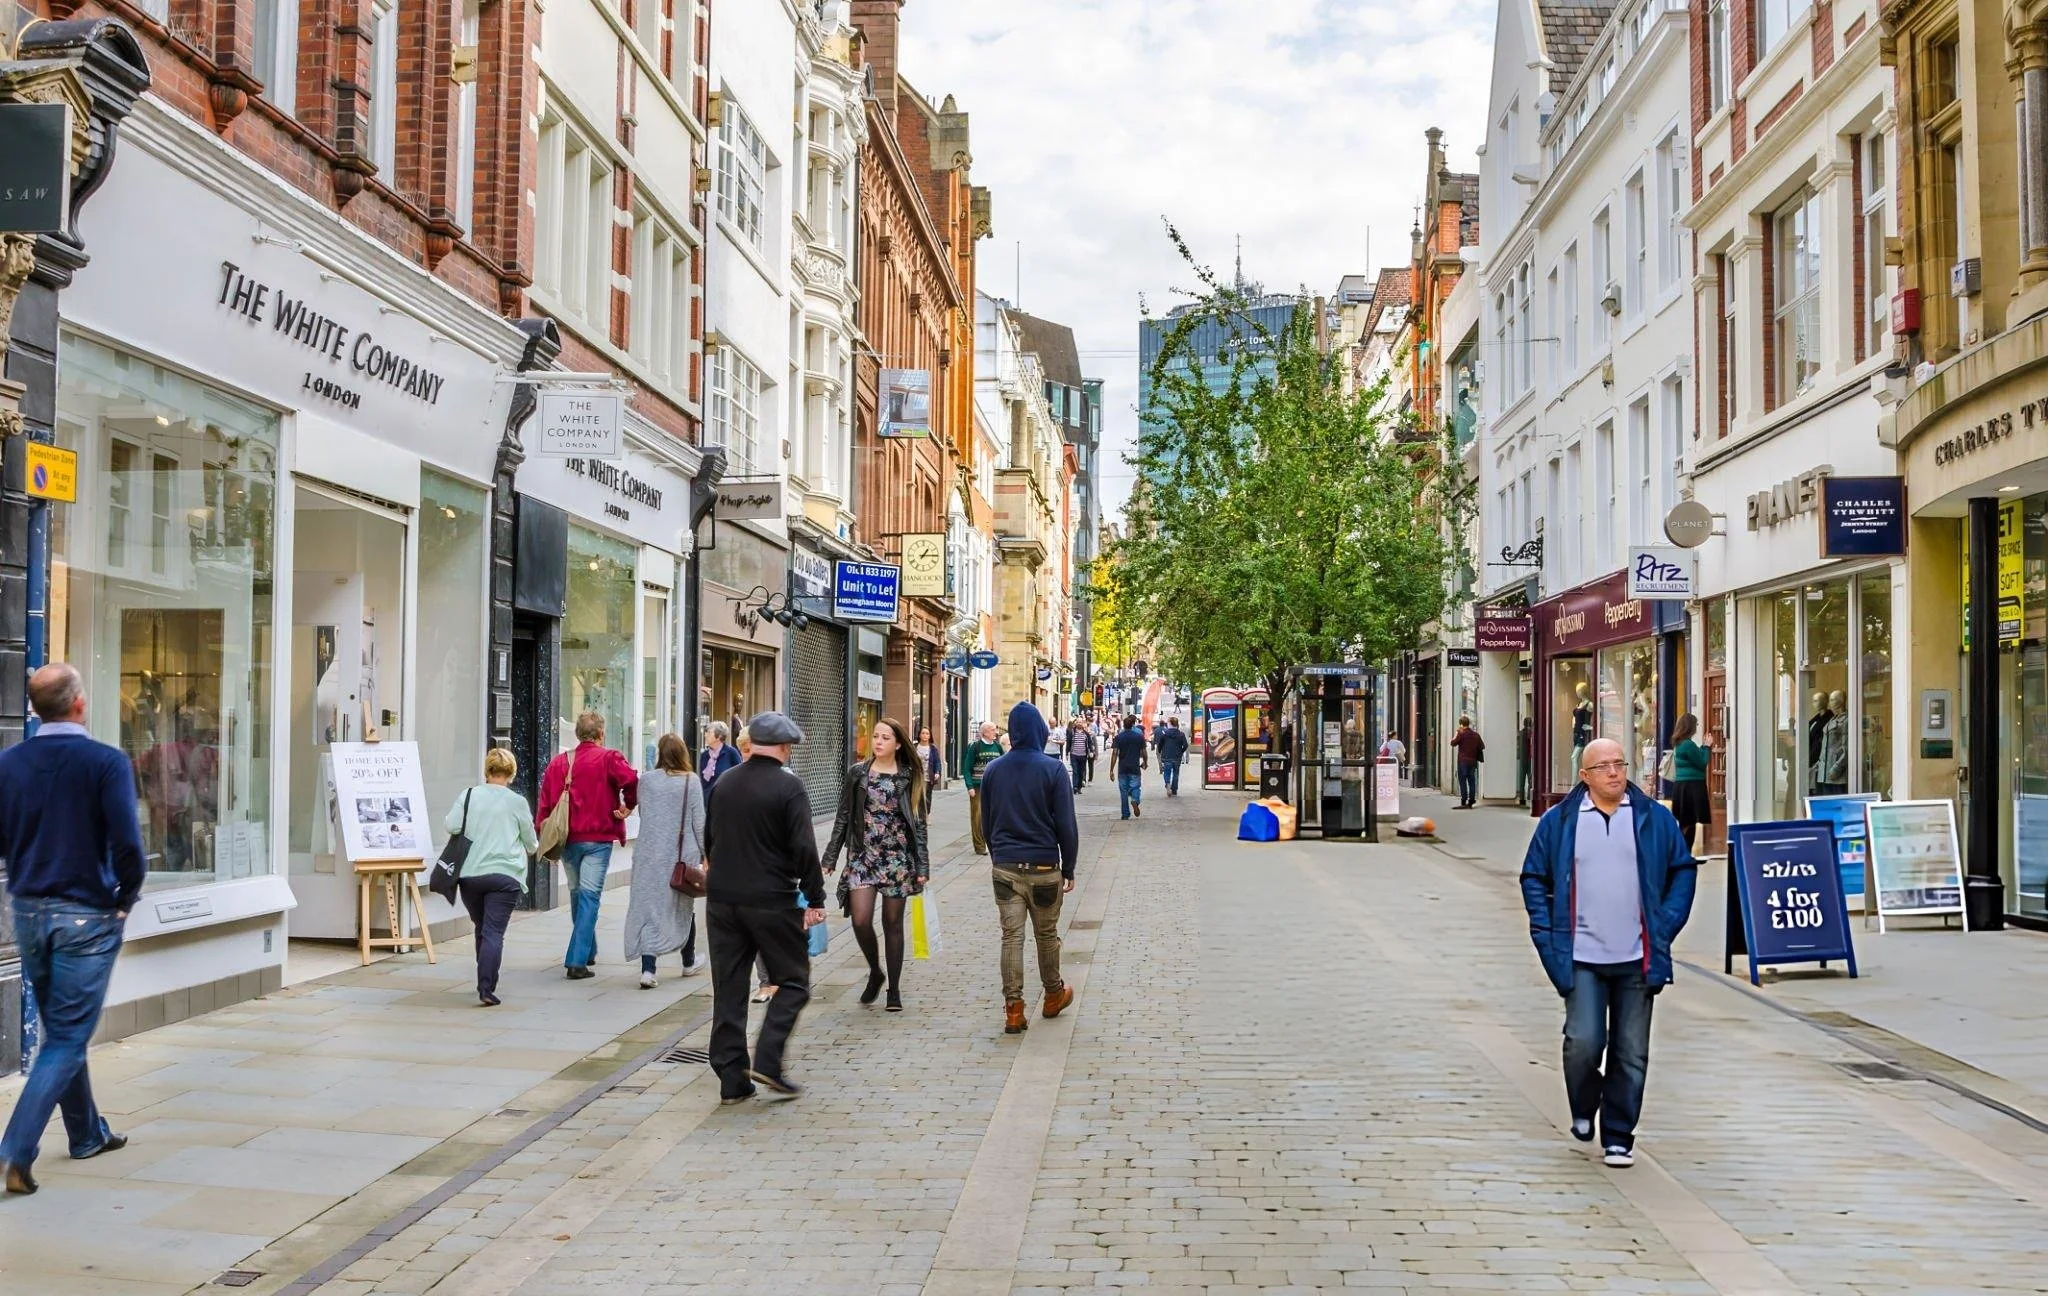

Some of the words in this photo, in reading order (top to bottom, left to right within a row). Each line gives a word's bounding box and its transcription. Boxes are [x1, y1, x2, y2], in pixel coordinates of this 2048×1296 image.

[219, 260, 269, 321] THE
[274, 289, 348, 360] WHITE
[352, 332, 444, 405] COMPANY
[302, 372, 361, 409] LONDON
[569, 401, 592, 411] THE
[559, 415, 600, 425] WHITE
[547, 427, 610, 439] COMPANY
[1935, 411, 2013, 467] CHARLES
[566, 458, 585, 475] THE
[589, 459, 620, 491] WHITE
[621, 470, 663, 510] COMPANY
[604, 501, 630, 521] LONDON
[1833, 508, 1896, 516] TYRWHITT
[1671, 520, 1709, 528] PLANET
[865, 567, 879, 577] 833
[880, 569, 897, 579] 1197
[842, 580, 865, 593] Unit
[866, 582, 878, 594] To
[879, 584, 894, 596] Let
[1635, 582, 1688, 590] RECRUITMENT
[875, 600, 894, 608] Moore
[1604, 581, 1642, 630] Pepperberry
[1479, 621, 1527, 635] BRAVISSIMO
[1554, 603, 1585, 645] BRAVISSIMO
[1480, 635, 1526, 648] Pepperberry
[1313, 667, 1359, 675] TELEPHONE
[344, 757, 370, 765] HOME
[375, 756, 405, 765] EVENT
[351, 768, 374, 778] 20%
[377, 767, 403, 778] OFF
[1786, 887, 1821, 907] for
